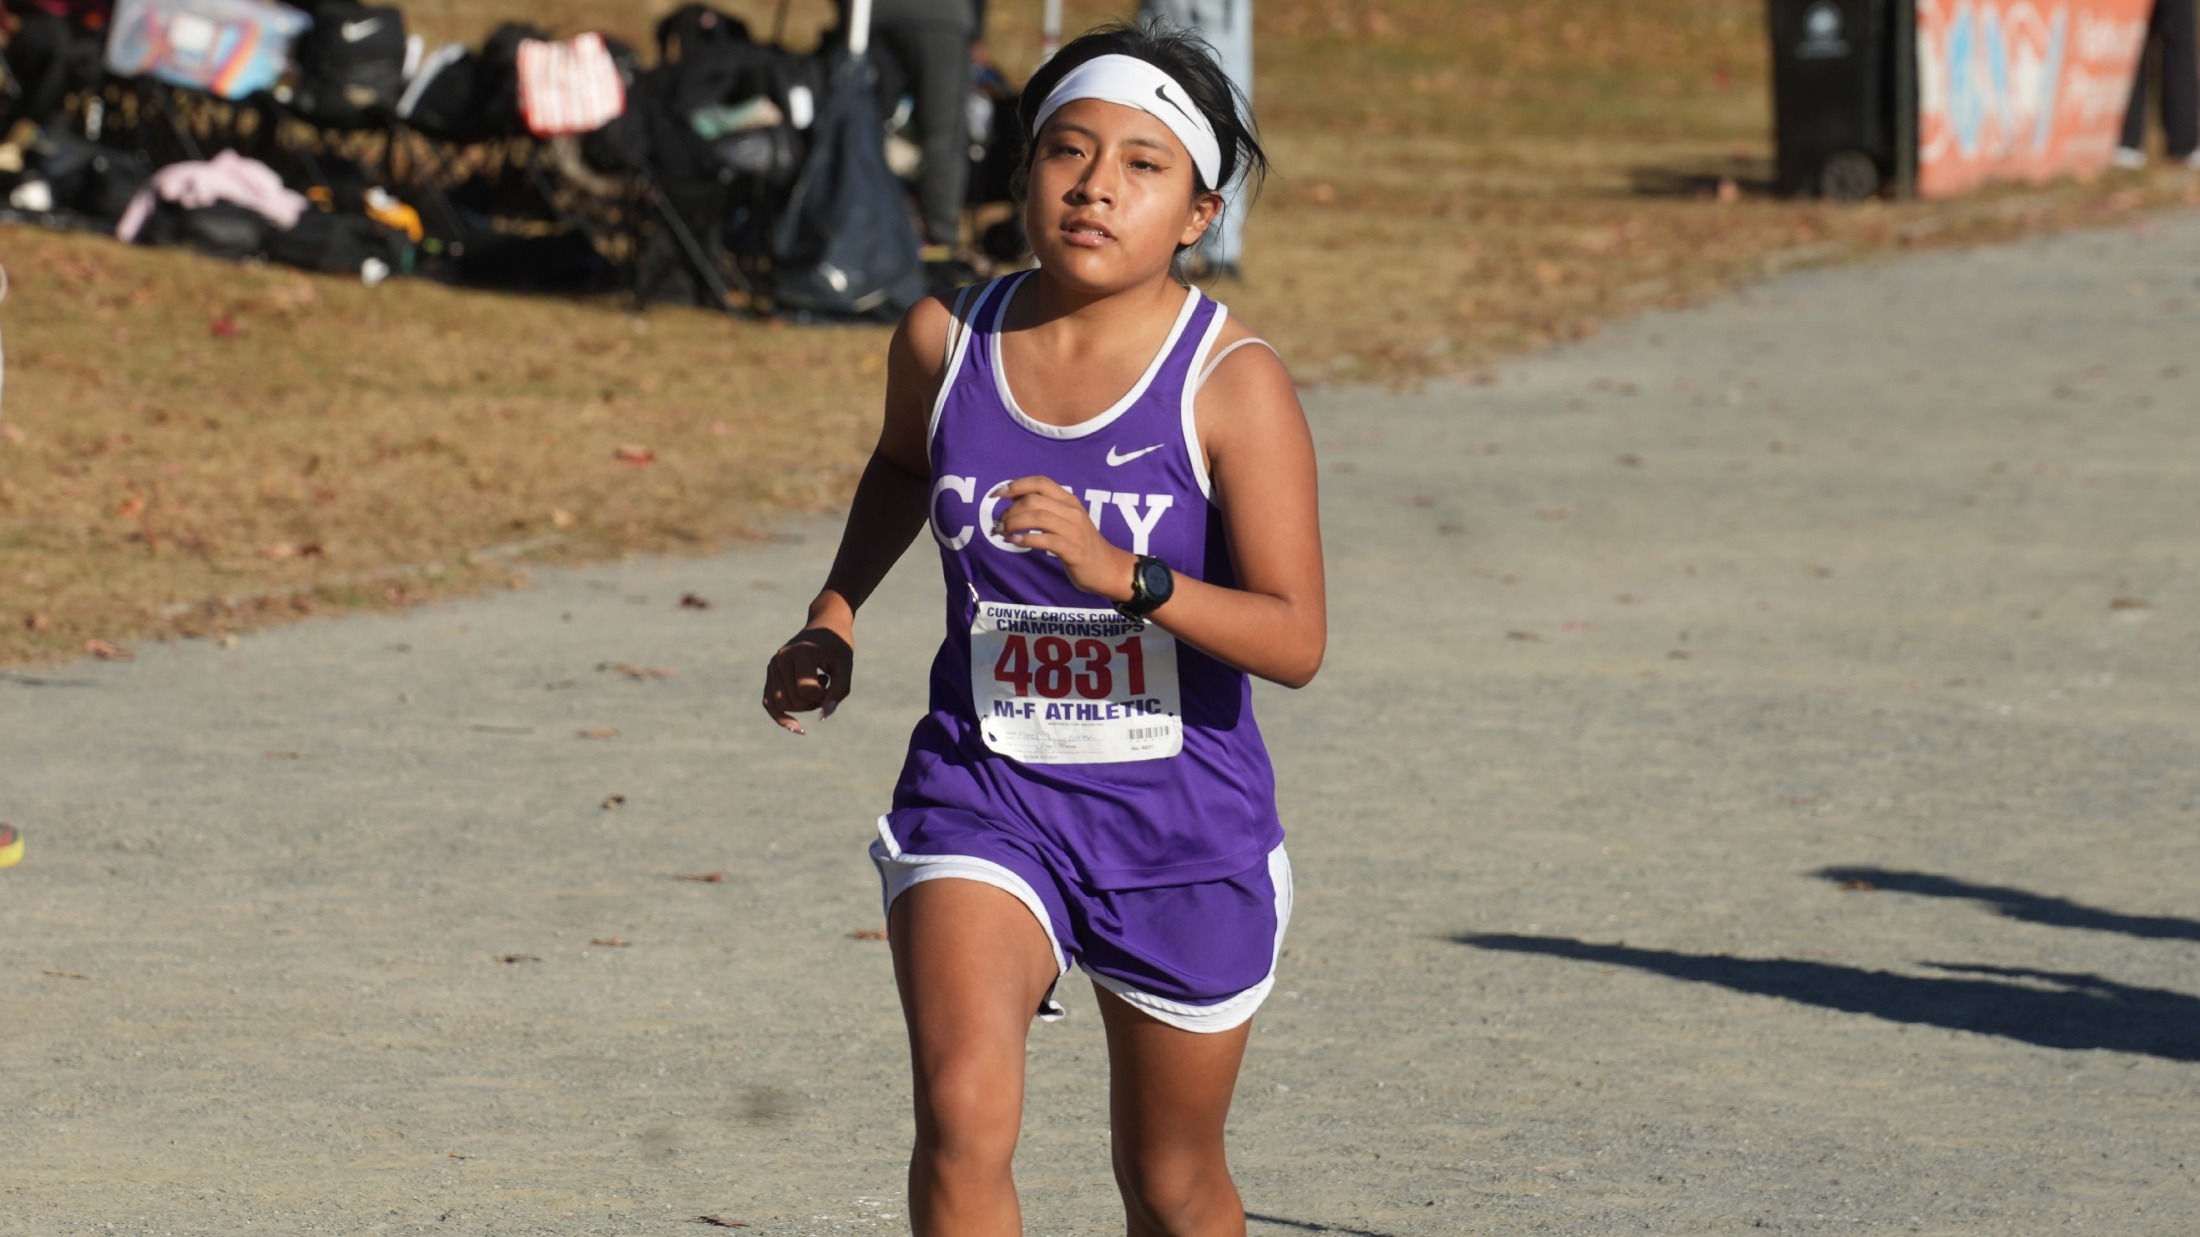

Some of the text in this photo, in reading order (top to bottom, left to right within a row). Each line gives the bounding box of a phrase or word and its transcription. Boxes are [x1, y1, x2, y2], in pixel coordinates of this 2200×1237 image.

[987, 606, 1135, 624] CUNYAC CROSS COUN
[996, 618, 1145, 637] CHAMPIONSHIPS
[994, 634, 1146, 699] 4831
[994, 698, 1161, 720] M-F ATHLETIC
